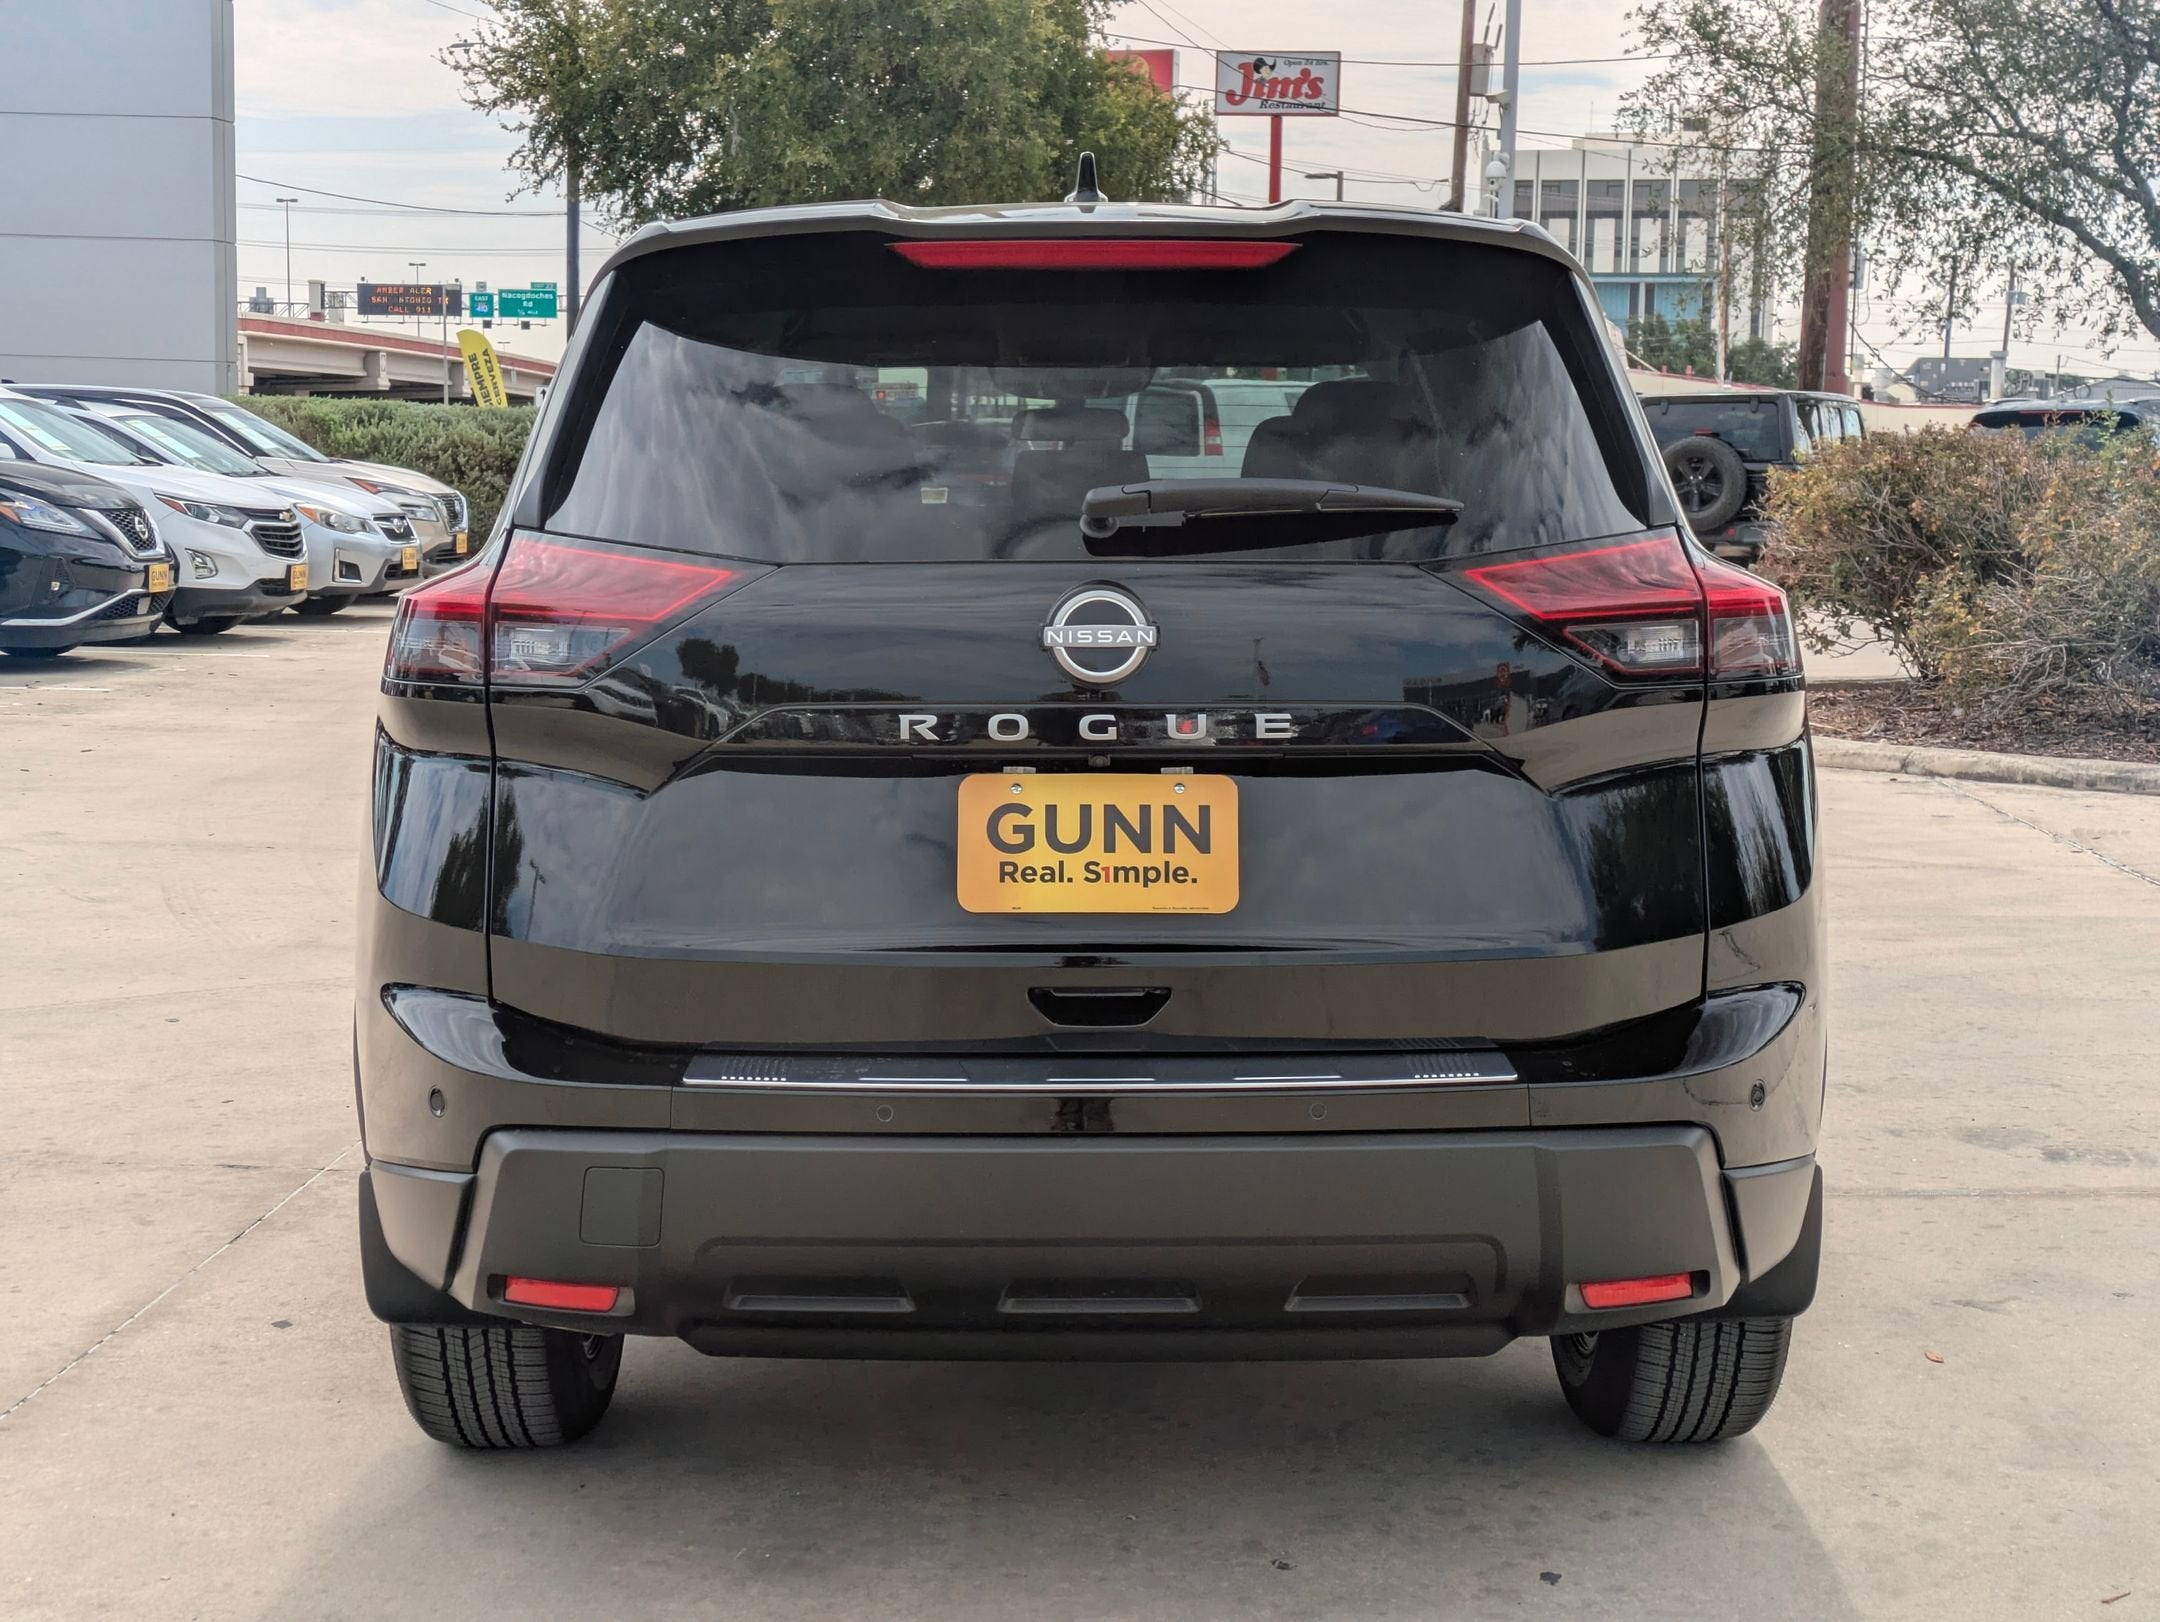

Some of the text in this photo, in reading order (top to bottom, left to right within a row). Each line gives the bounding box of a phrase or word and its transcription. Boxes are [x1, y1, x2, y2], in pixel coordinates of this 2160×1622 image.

[1225, 62, 1325, 106] Jim's
[1259, 100, 1327, 110] Restaurant
[376, 286, 404, 294] AMBER
[501, 292, 554, 300] Nacogdoches
[370, 296, 388, 304] SAN
[522, 300, 534, 308] Rd
[482, 348, 502, 405] CERVEZA
[151, 570, 168, 581] GUNN
[1046, 628, 1155, 644] NISSAN
[898, 713, 1293, 741] ROGUE
[986, 802, 1212, 855] GUNN
[999, 860, 1074, 884] Real.
